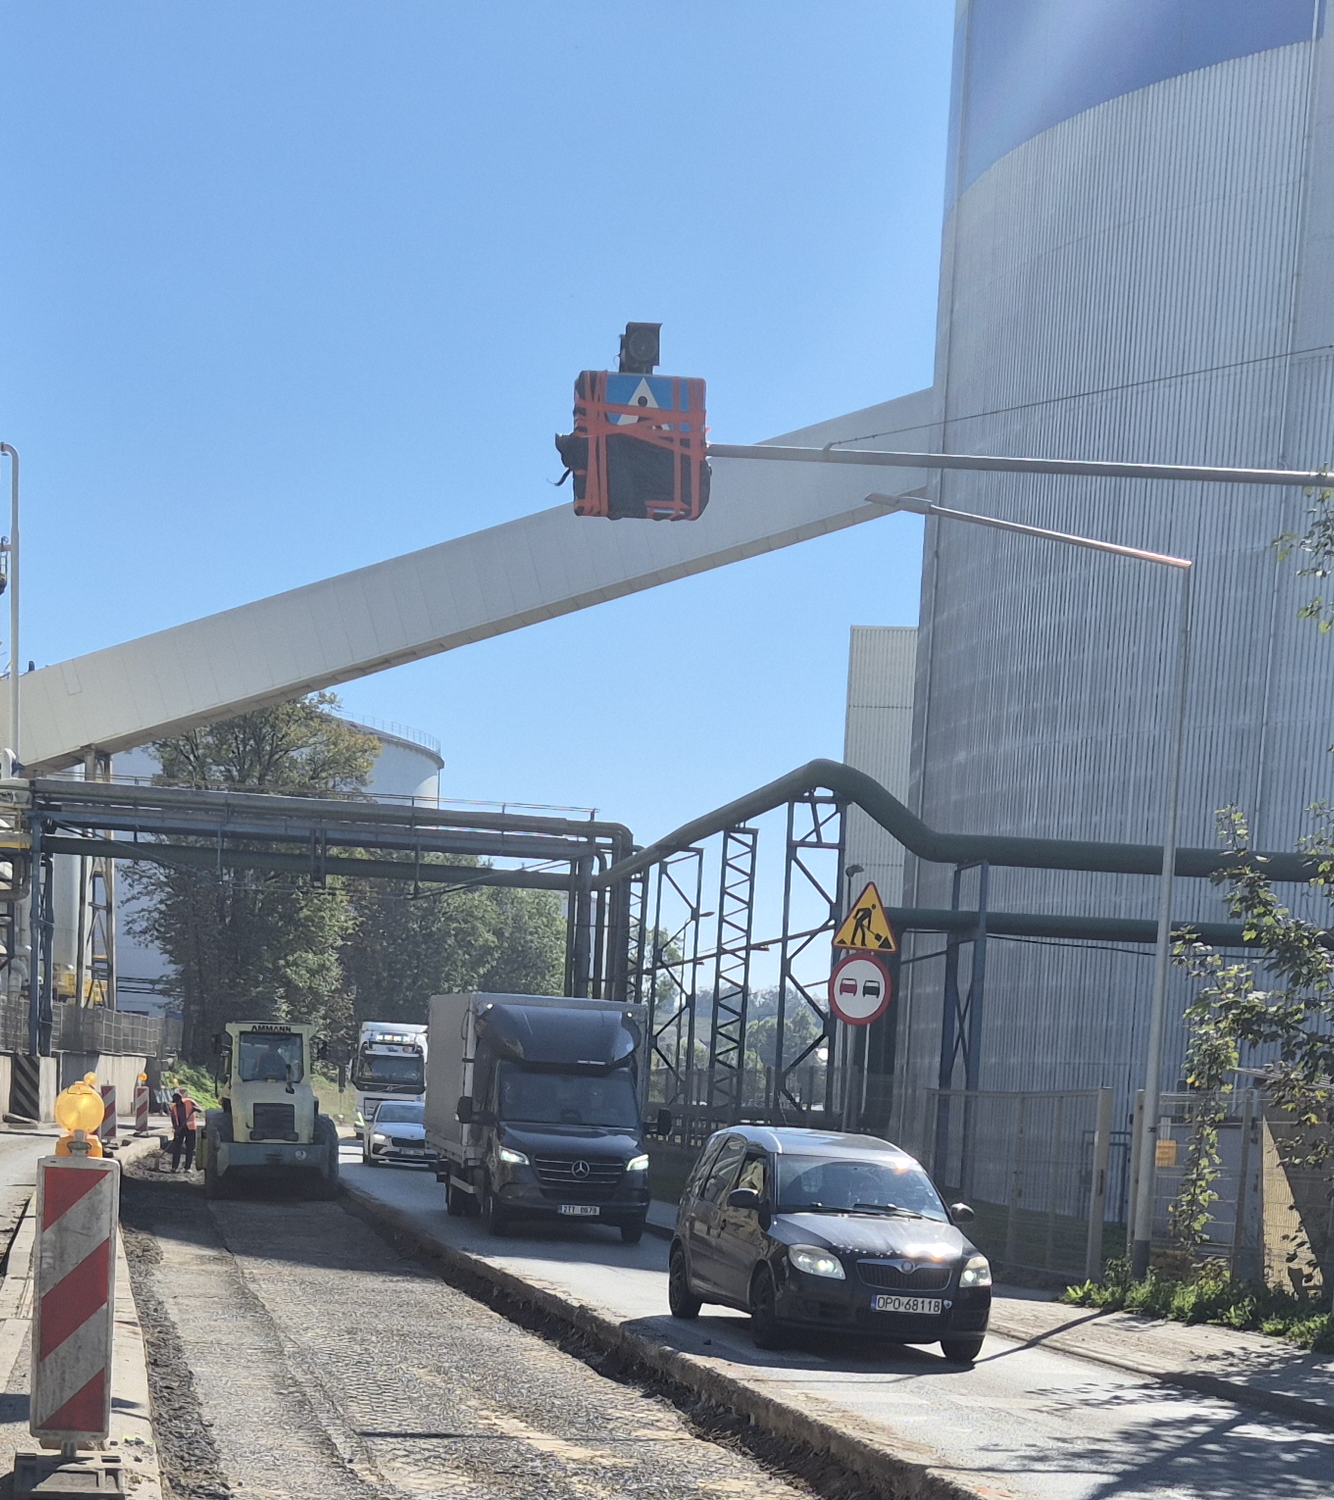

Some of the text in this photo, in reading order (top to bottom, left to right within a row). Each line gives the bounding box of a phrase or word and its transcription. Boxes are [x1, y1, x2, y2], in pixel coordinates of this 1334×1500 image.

[251, 1024, 292, 1033] AMMANN
[877, 1296, 941, 1313] OPO 68118
